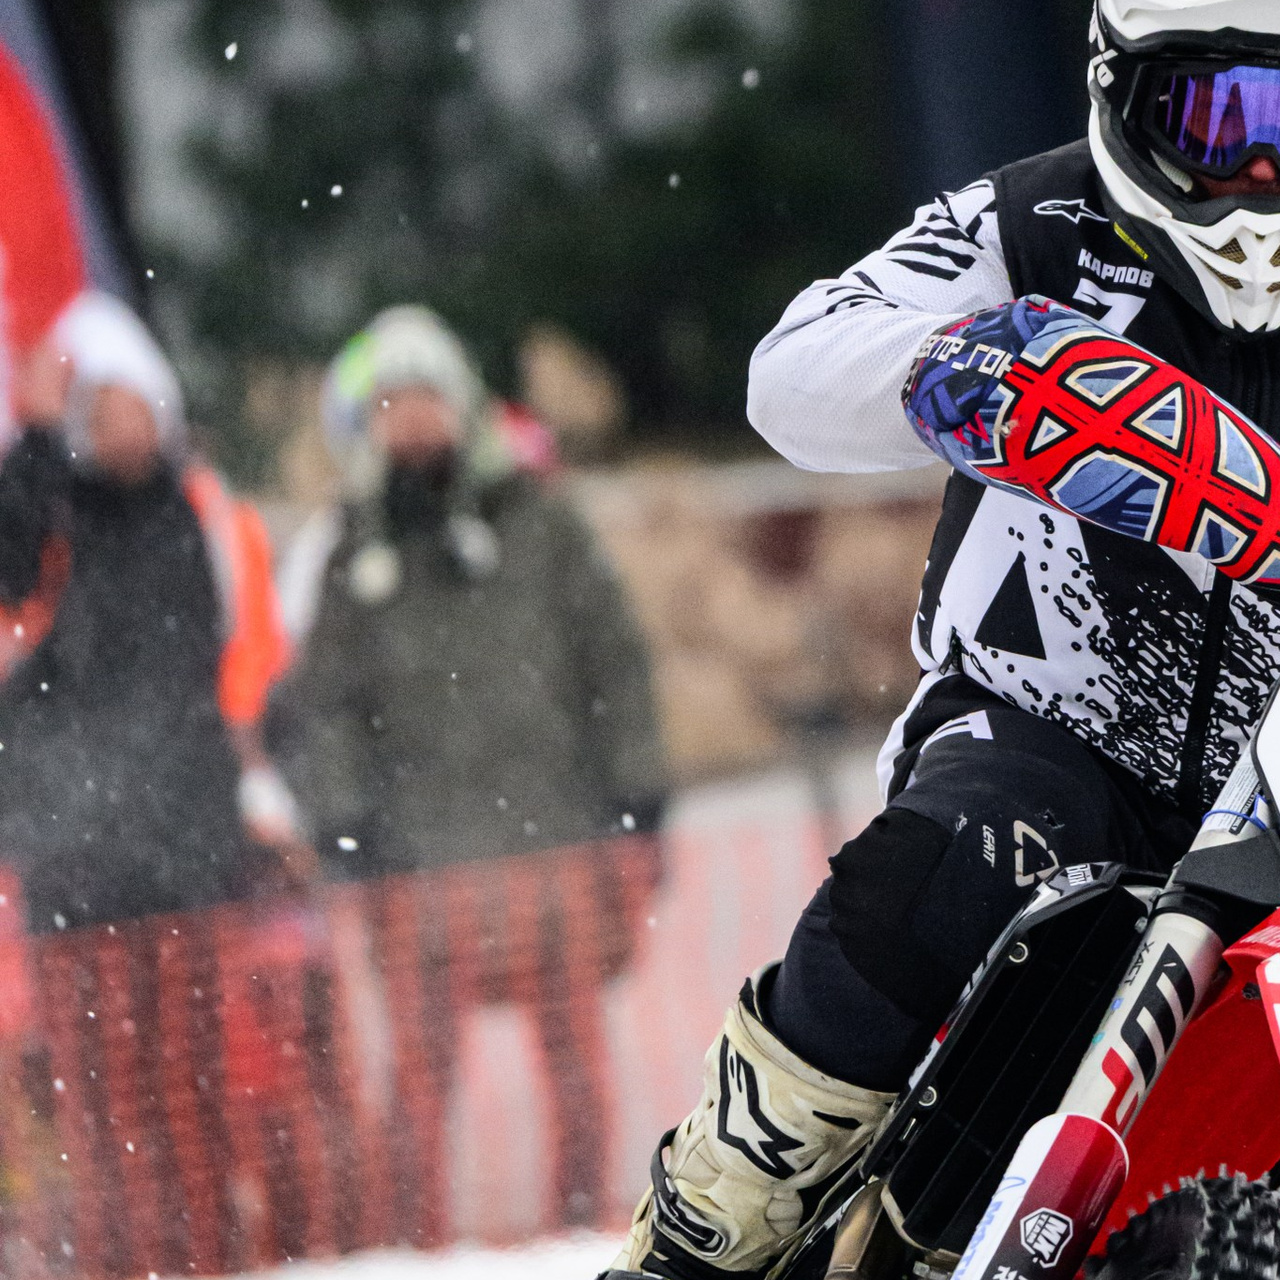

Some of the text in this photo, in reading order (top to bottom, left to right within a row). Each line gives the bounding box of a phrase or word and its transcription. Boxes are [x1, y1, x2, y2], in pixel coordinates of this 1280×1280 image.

[1077, 248, 1154, 288] КАРПОВ
[1072, 277, 1146, 335] 7
[1122, 941, 1155, 986] XACT
[1032, 1216, 1068, 1261] MX
